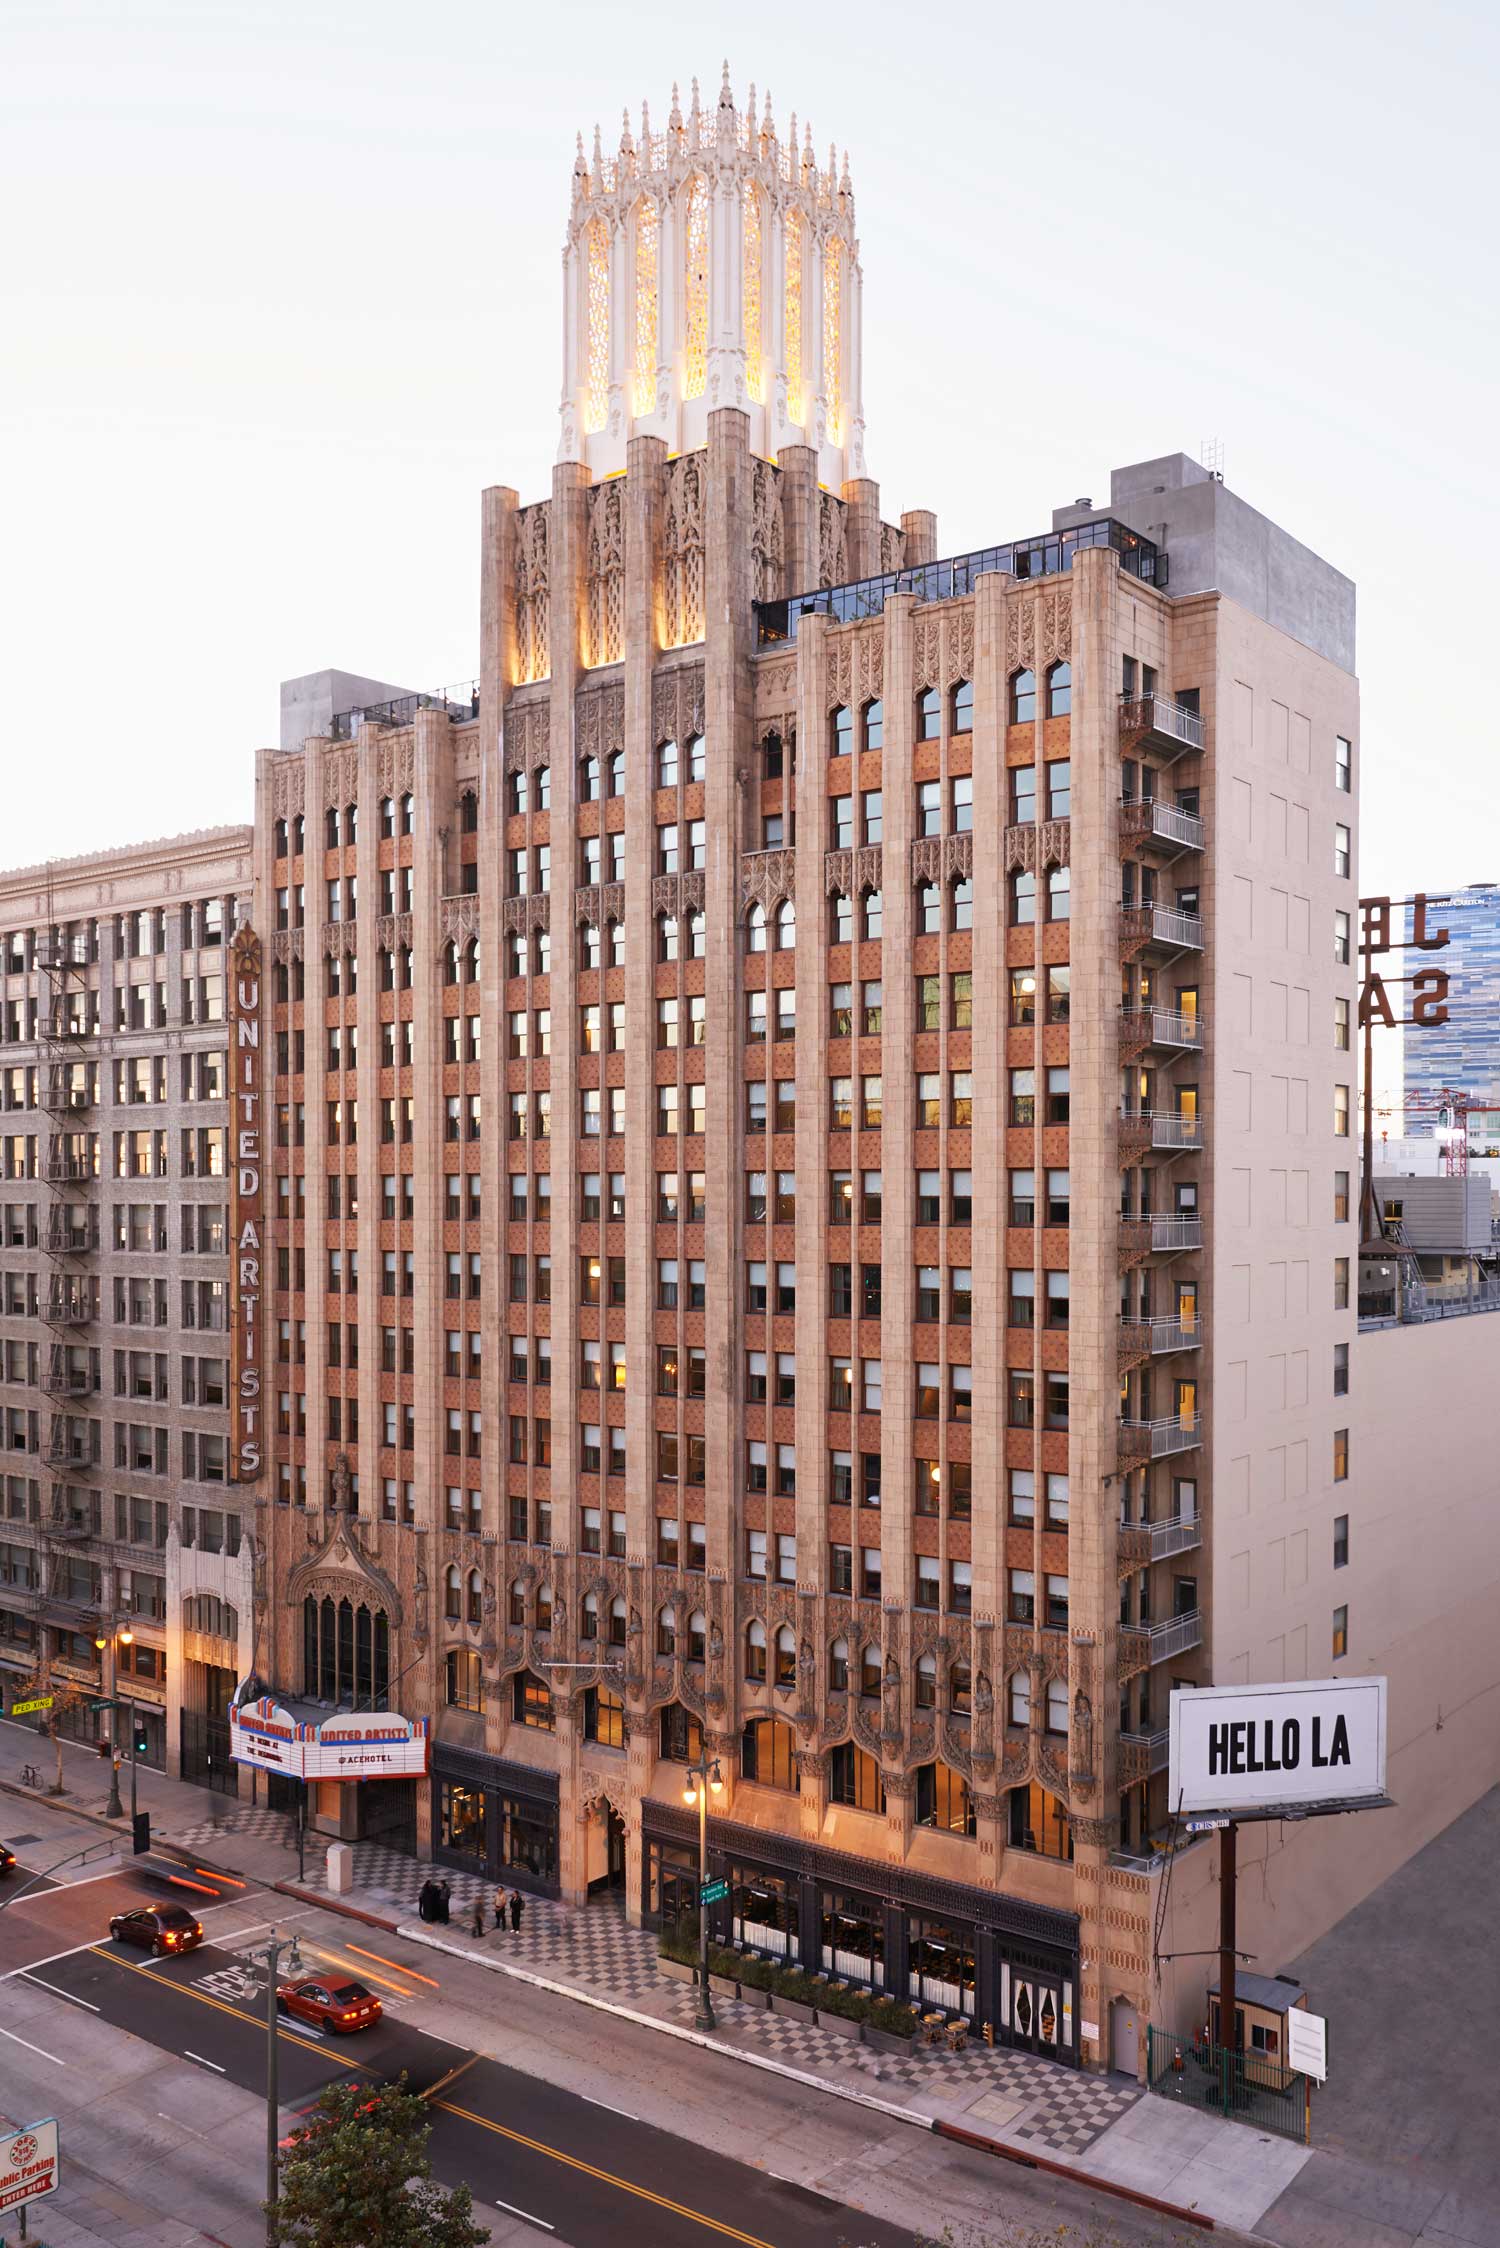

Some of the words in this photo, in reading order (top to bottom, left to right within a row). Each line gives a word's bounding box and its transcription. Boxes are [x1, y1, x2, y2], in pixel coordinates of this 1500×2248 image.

[238, 979, 259, 1196] UNITED
[239, 1220, 260, 1471] ARTISTS
[15, 1703, 31, 1713] PED
[33, 1700, 51, 1710] XING
[321, 1729, 361, 1741] UNITED
[365, 1727, 408, 1740] ARTISTS
[1209, 1718, 1301, 1775] HELLO
[1312, 1714, 1351, 1767] LA
[0, 2171, 20, 2188] ublic
[22, 2157, 55, 2178] Parking
[2, 2189, 26, 2205] ENTER
[27, 2180, 47, 2193] HERE
